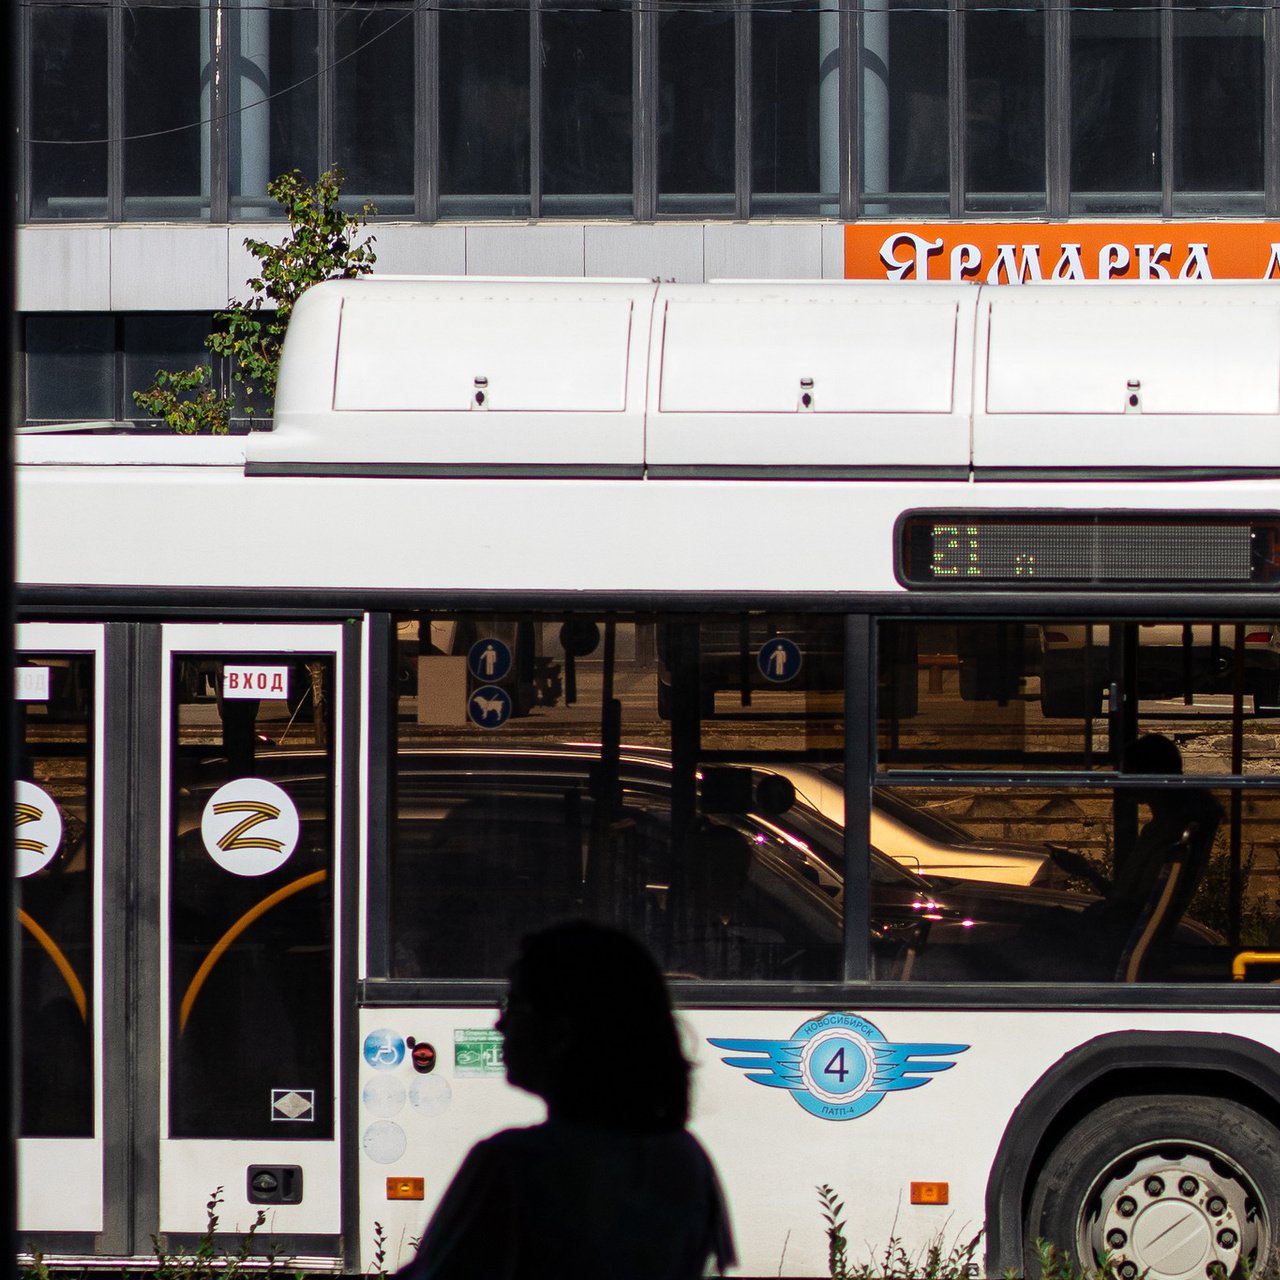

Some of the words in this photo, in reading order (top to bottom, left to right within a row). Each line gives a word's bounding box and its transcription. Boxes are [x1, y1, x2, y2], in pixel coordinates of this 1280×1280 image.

[879, 232, 1213, 285] ЯРМАРКА
[229, 672, 283, 693] ВХОД
[212, 800, 286, 853] Z
[804, 1016, 874, 1037] НОВОСИБИРСК
[824, 1047, 849, 1083] 4
[821, 1106, 854, 1116] ПАТП-4
